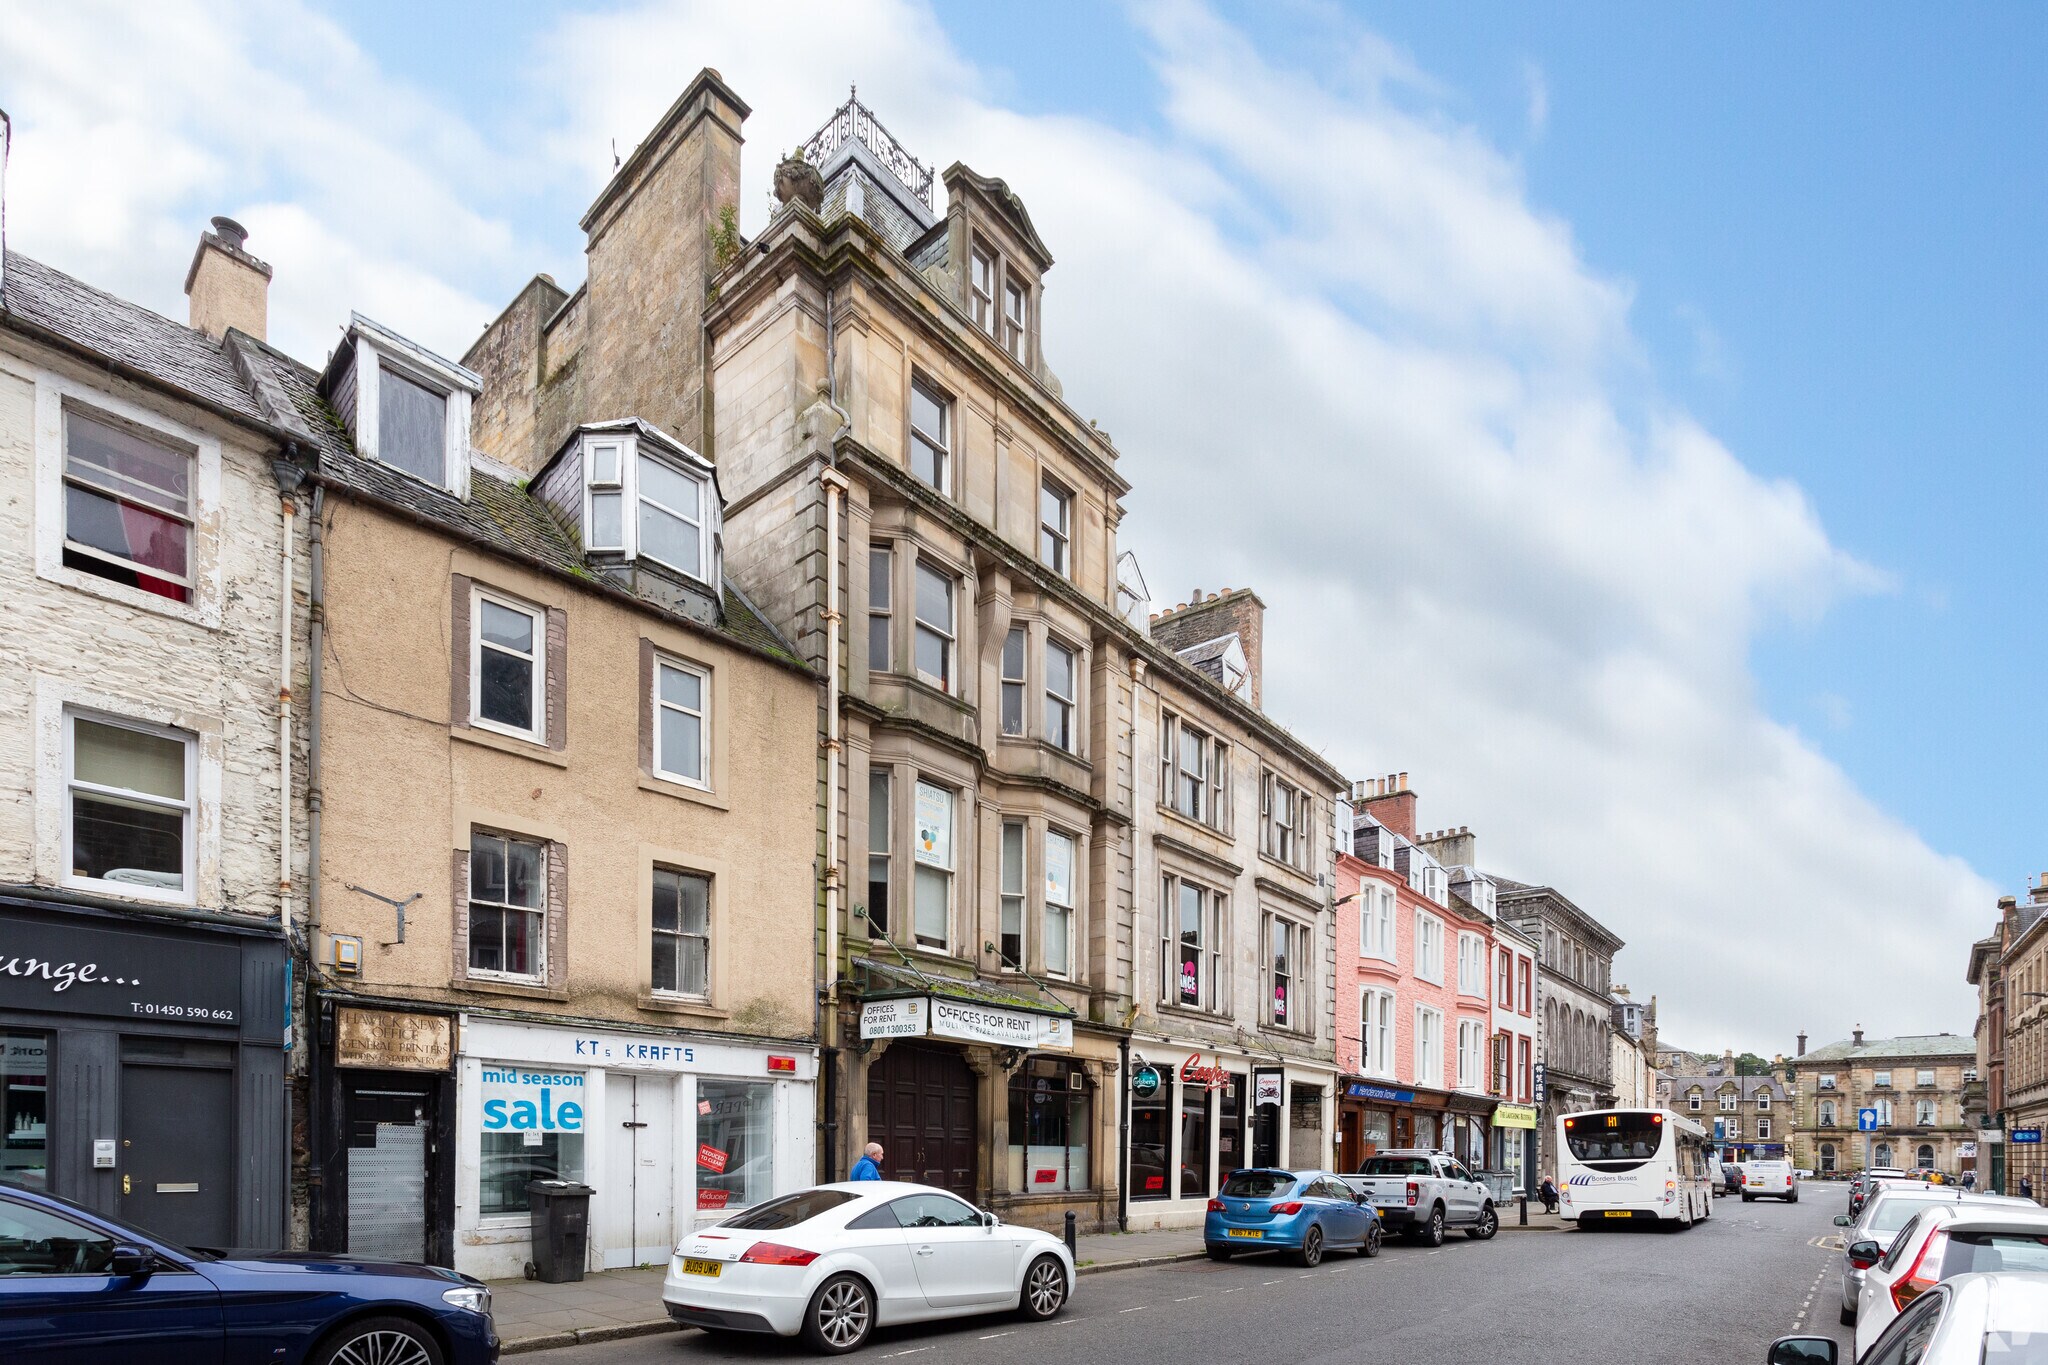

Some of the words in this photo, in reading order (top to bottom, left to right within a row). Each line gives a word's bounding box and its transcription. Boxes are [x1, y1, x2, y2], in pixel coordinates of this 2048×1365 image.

[920, 786, 944, 803] SHIATSU
[131, 1002, 143, 1013] T:
[145, 1003, 183, 1016] 01450
[186, 1006, 209, 1018] 590
[212, 1009, 233, 1020] 662
[867, 1004, 894, 1015] OFFICES
[345, 1012, 401, 1028] HAWICK
[409, 1017, 445, 1031] NEWS
[863, 1015, 877, 1024] FOR
[878, 1014, 897, 1023] RENT
[938, 1005, 981, 1024] OFFICES
[983, 1015, 1006, 1027] FOR
[1007, 1018, 1031, 1032] RENT
[372, 1026, 419, 1040] OFFICE
[869, 1026, 885, 1035] 0800
[886, 1024, 916, 1034] 1300353
[975, 1026, 995, 1036] SIZES
[996, 1029, 1031, 1041] AVAILABLE
[342, 1038, 393, 1051] GENERAL
[399, 1042, 448, 1055] PRINTERS
[626, 1044, 694, 1062] KRAFTS
[342, 1051, 382, 1061] WEDDING
[385, 1053, 437, 1065] STATIONERY
[482, 1068, 517, 1083] mid
[522, 1073, 583, 1086] season
[1133, 1076, 1155, 1087] Carlsberg
[1358, 1086, 1384, 1098] Hendersons
[483, 1088, 583, 1130] sale
[1607, 1116, 1617, 1127] H1
[702, 1149, 725, 1162] REDUCED
[700, 1190, 728, 1200] reduced
[707, 1201, 724, 1209] clear
[685, 1260, 703, 1272] BU09
[704, 1262, 718, 1275] UWR
